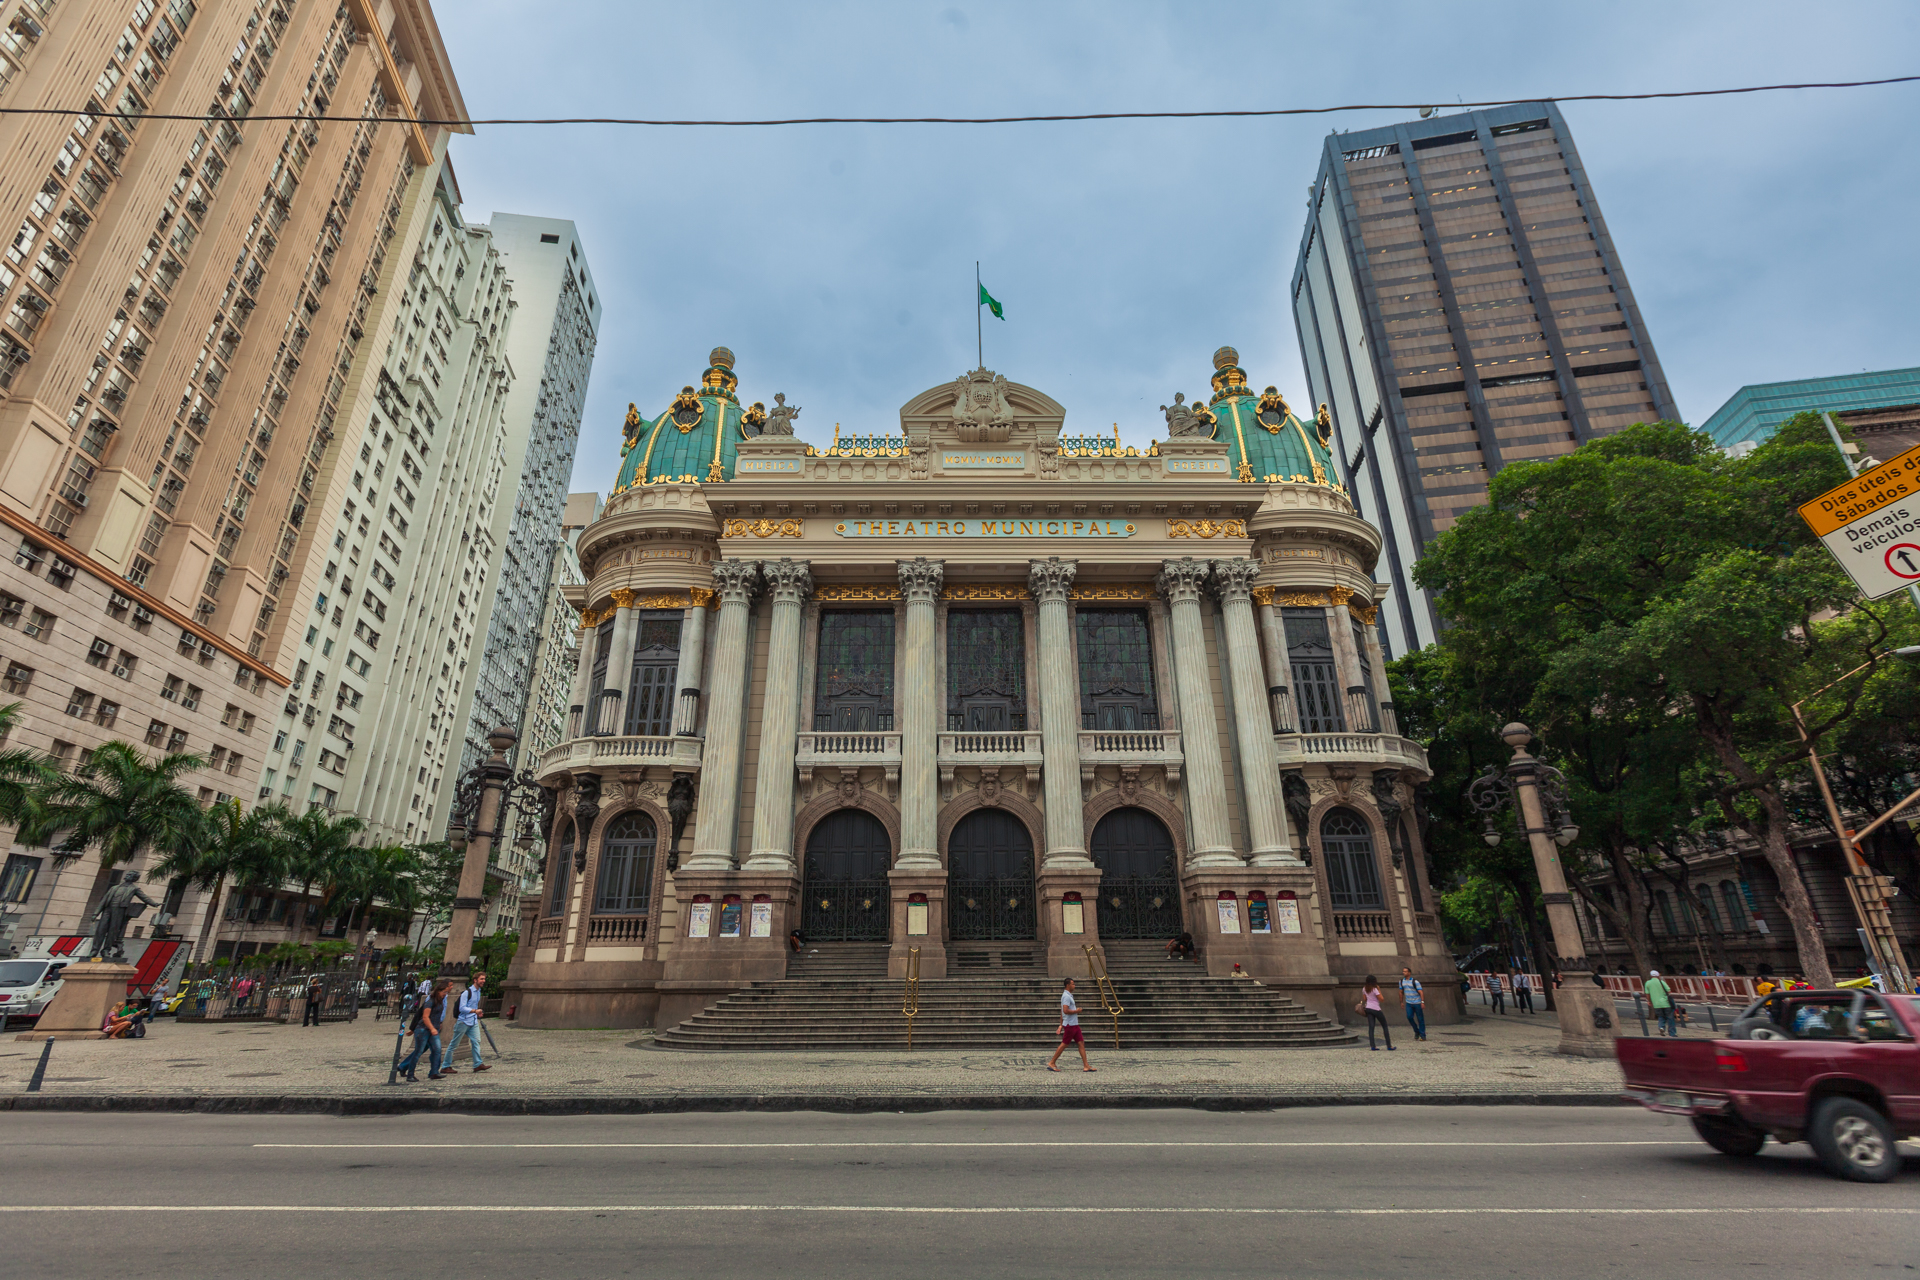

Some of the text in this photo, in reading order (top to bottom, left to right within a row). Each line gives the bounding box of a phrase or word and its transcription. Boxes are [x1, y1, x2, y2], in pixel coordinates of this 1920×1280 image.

[745, 461, 795, 470] MUSICA
[1173, 461, 1220, 470] POESIA
[1820, 490, 1857, 512] Dias
[1858, 467, 1902, 493] úteis
[1834, 483, 1908, 522] Sábados
[853, 521, 1118, 535] THEATRO MUNICIPAL
[1844, 509, 1910, 542] Demais
[1852, 518, 1920, 554] veículos
[1275, 549, 1321, 559] GOETHE
